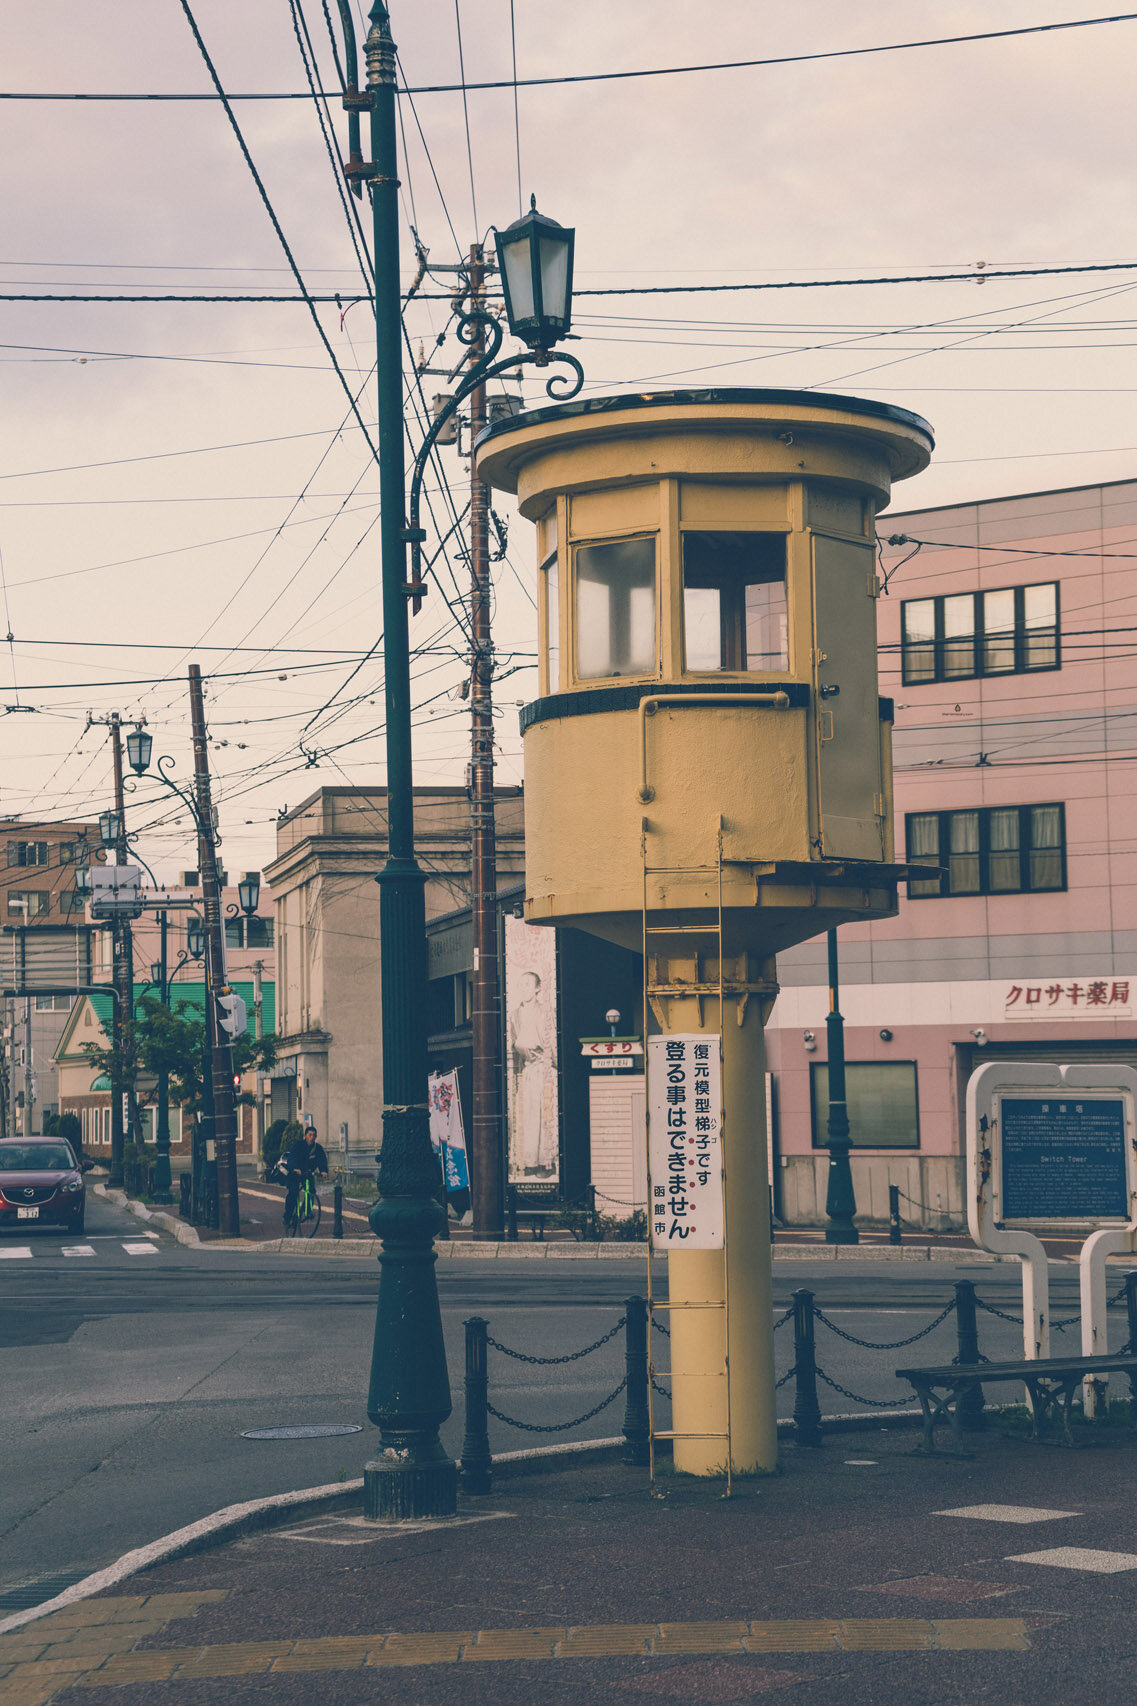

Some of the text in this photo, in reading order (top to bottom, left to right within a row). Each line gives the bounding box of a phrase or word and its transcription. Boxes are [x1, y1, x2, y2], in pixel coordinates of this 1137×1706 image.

[1005, 981, 1130, 1007] クロサキ薬局
[590, 1043, 632, 1053] くすり
[694, 1044, 711, 1186] 復元模型梯子です
[665, 1041, 690, 1240] 登る事はできません
[654, 1185, 666, 1234] 函館市
